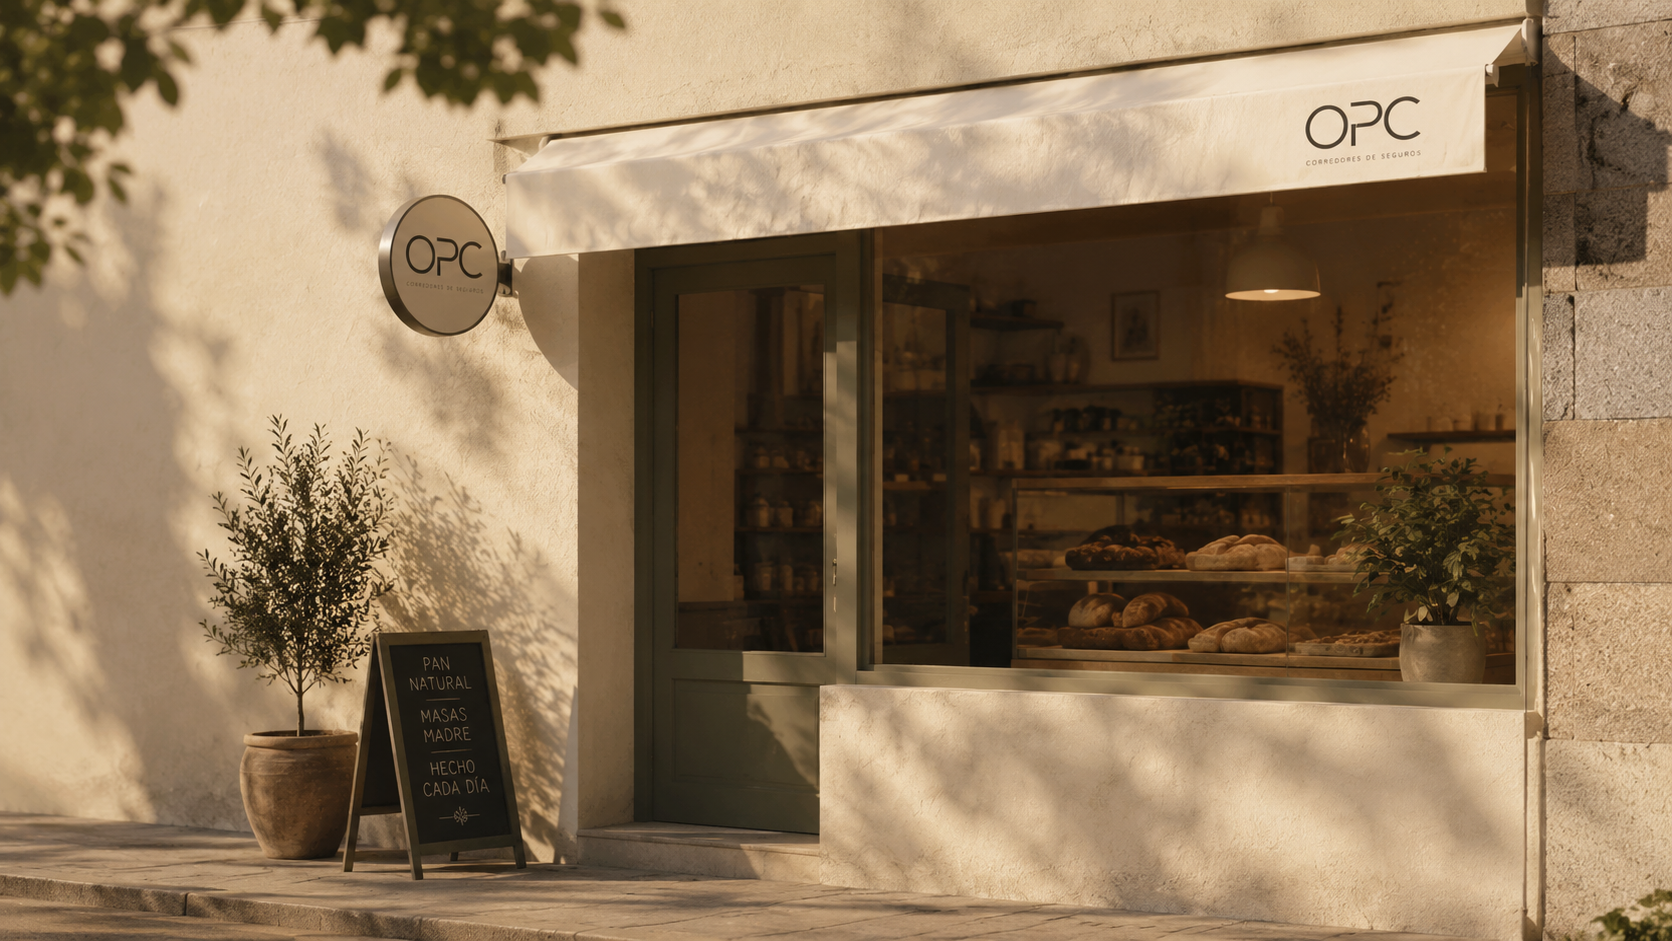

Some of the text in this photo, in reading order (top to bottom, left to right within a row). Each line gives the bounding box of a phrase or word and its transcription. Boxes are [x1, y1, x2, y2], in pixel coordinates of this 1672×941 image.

[1305, 96, 1421, 149] OPC
[1305, 155, 1361, 166] CORREDORES
[1381, 150, 1421, 159] SEGUROS
[405, 235, 483, 279] OPC
[422, 656, 450, 671] PAN
[409, 675, 472, 691] NATURAL
[420, 707, 468, 723] MASAS
[423, 726, 472, 743] MADRE
[429, 759, 476, 776] HECHO
[423, 776, 490, 797] CADA DÍA
